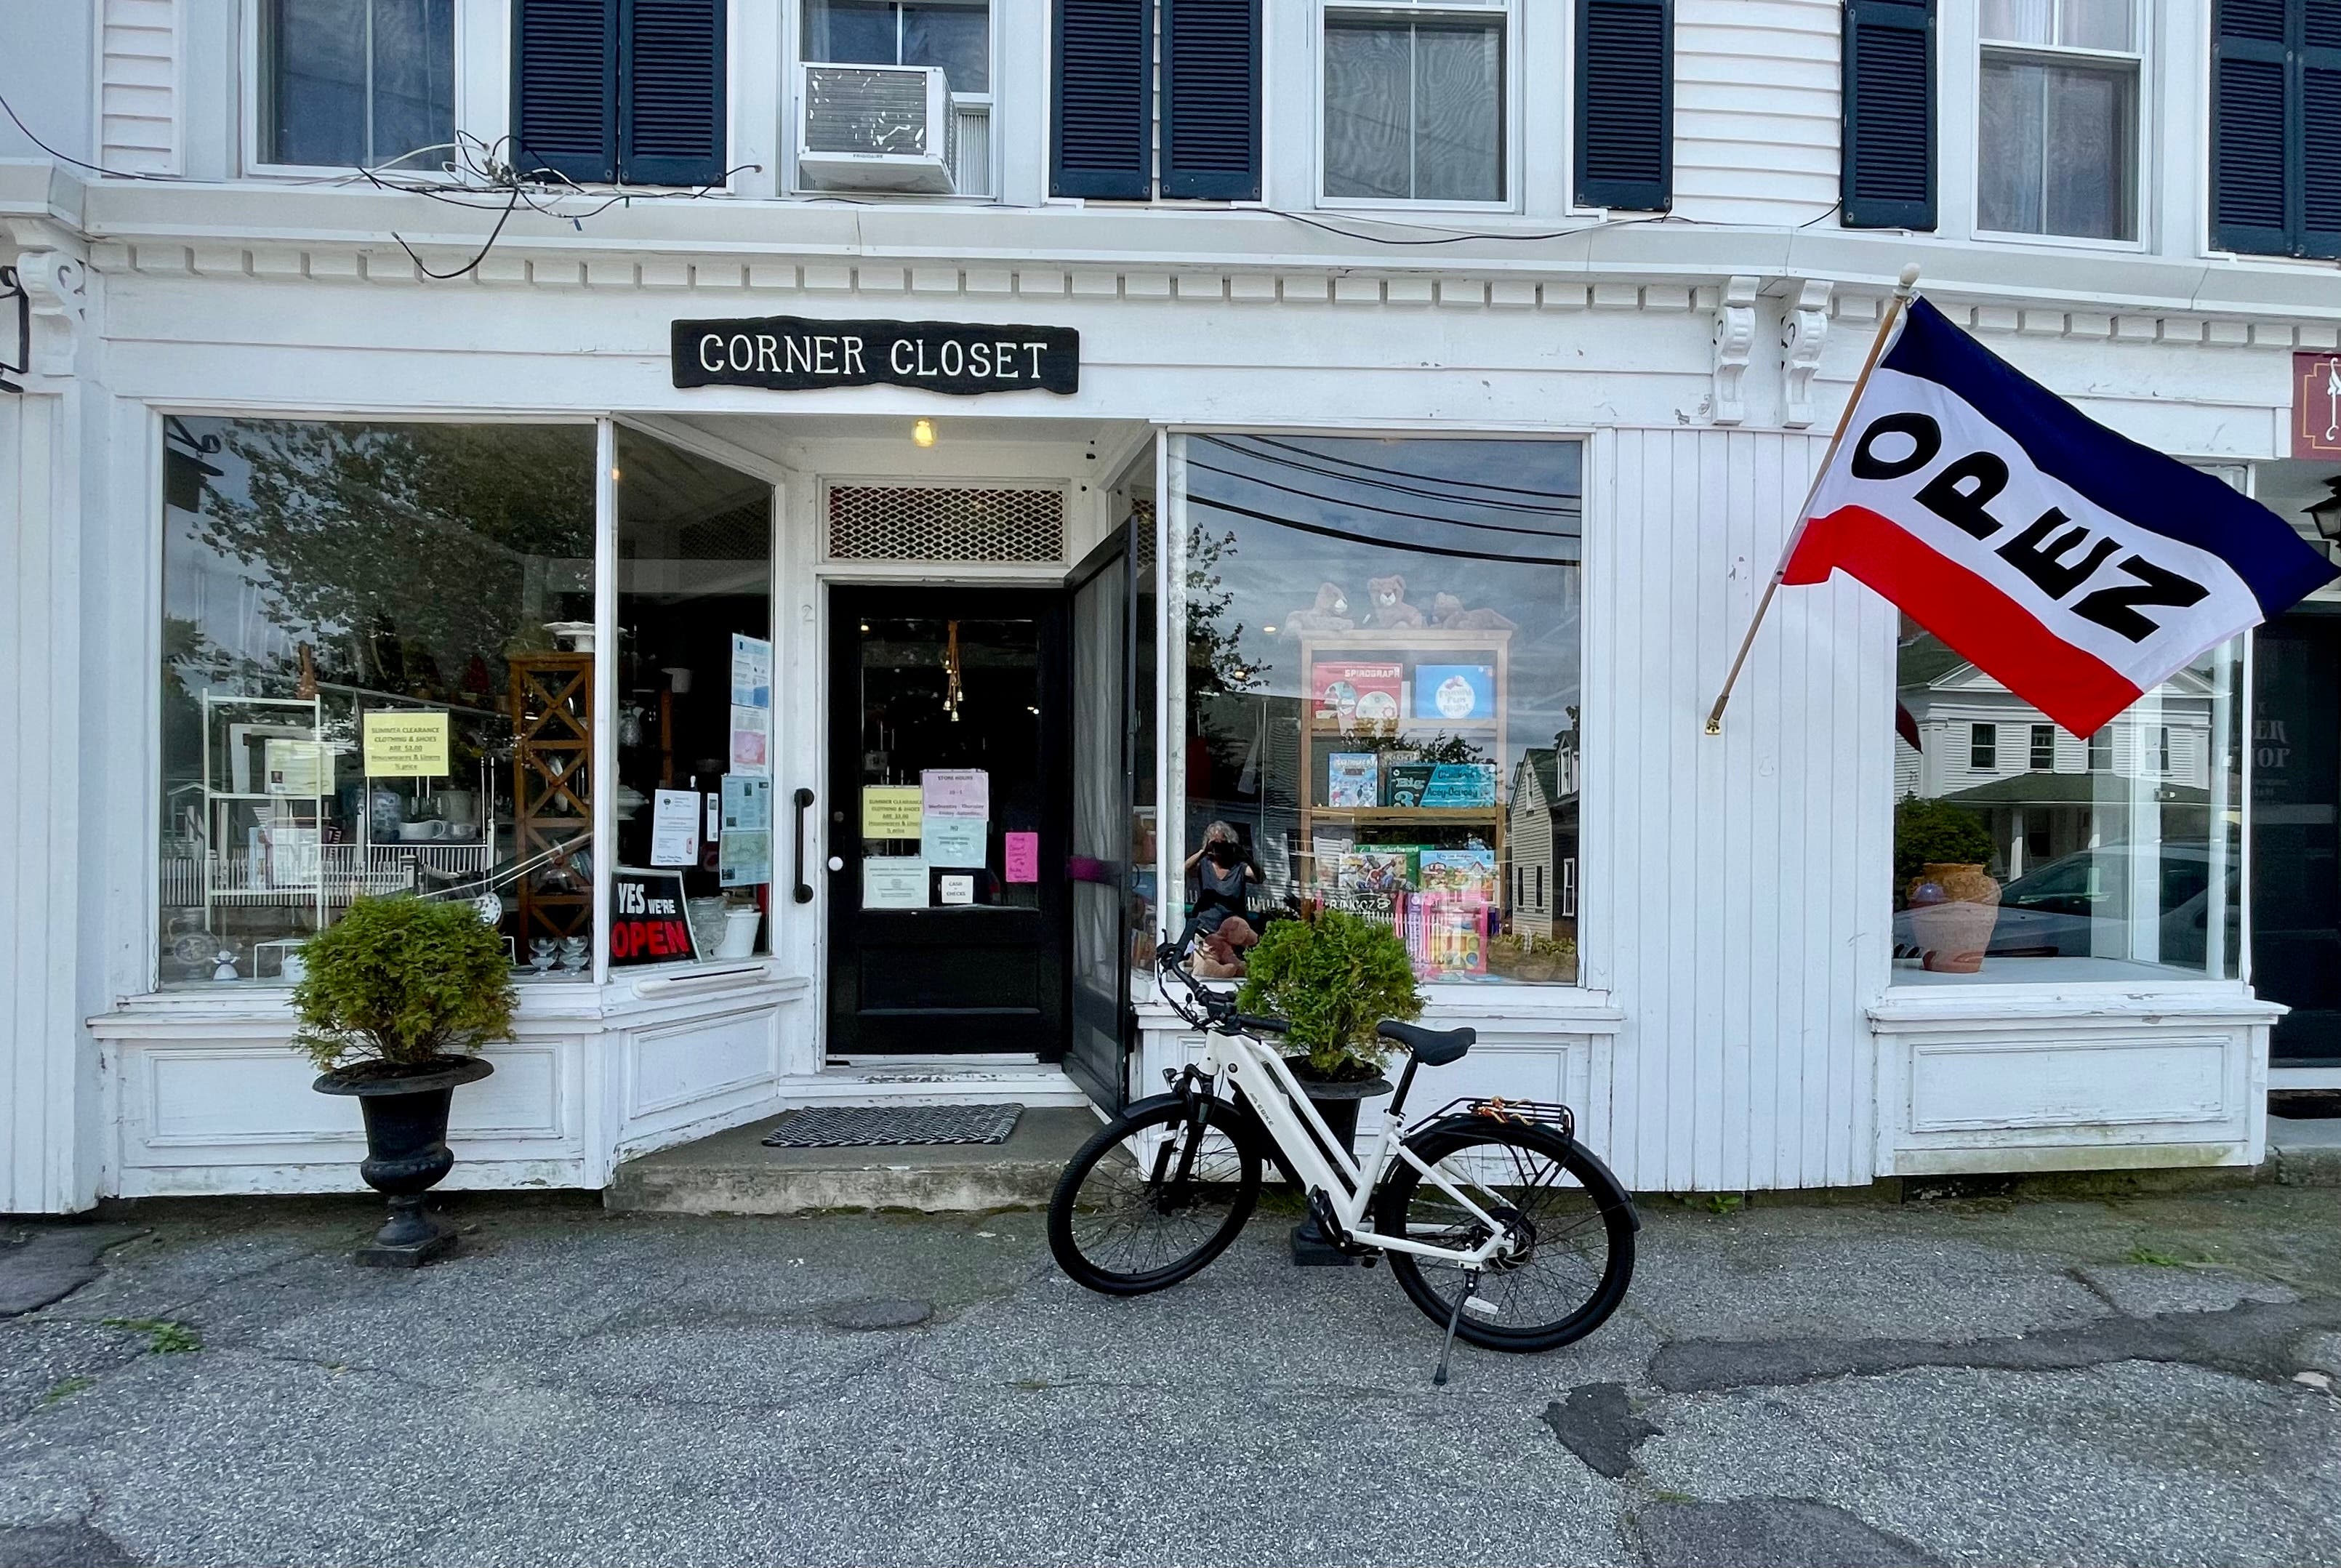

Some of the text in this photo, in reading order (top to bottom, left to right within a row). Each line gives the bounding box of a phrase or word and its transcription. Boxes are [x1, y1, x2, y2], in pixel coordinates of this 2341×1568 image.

[699, 333, 1048, 379] CORNER CLOSET
[1850, 411, 2211, 643] OPEN
[1344, 667, 1400, 678] SPIROGRAPH
[617, 882, 676, 914] YES WE'RE
[611, 920, 690, 958] OPEN
